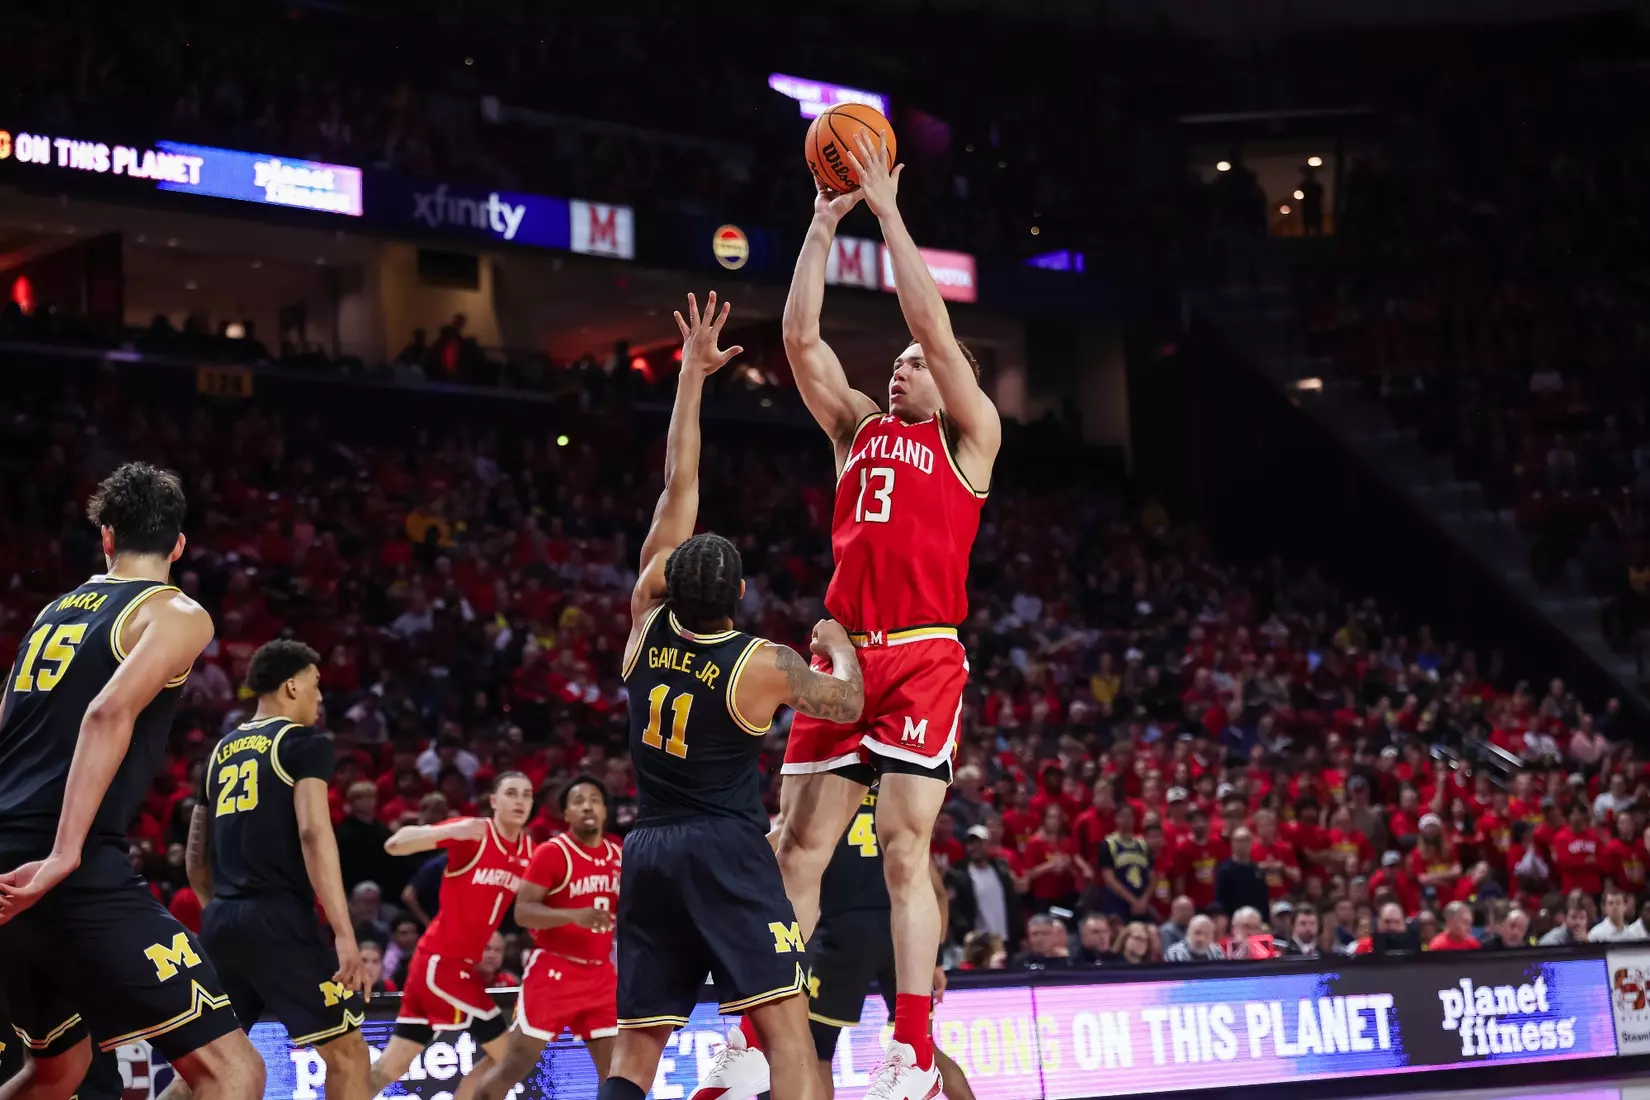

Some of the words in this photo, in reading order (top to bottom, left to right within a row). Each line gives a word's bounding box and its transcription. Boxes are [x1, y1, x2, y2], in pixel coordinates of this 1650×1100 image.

[15, 132, 50, 165] ON
[54, 137, 111, 173] THIS
[112, 145, 204, 185] PLANET
[413, 184, 527, 241] xfinity
[588, 204, 617, 248] M
[855, 467, 895, 523] 13
[56, 592, 109, 612] MARA
[14, 623, 89, 692] 15
[870, 630, 883, 645] M
[648, 646, 696, 674] GAYLE
[695, 660, 721, 690] JR.
[642, 683, 694, 760] 11
[901, 715, 929, 744] M
[216, 734, 273, 765] LENDEBORG
[215, 758, 259, 818] 23
[847, 813, 878, 857] 4
[488, 892, 504, 926] 1
[144, 931, 202, 983] M
[768, 921, 806, 953] M
[319, 981, 354, 1007] M
[1438, 974, 1550, 1030] planet
[1072, 1011, 1134, 1071] ON
[1141, 1004, 1238, 1066] THIS
[1244, 993, 1394, 1059] PLANET
[1459, 1016, 1577, 1056] fitness
